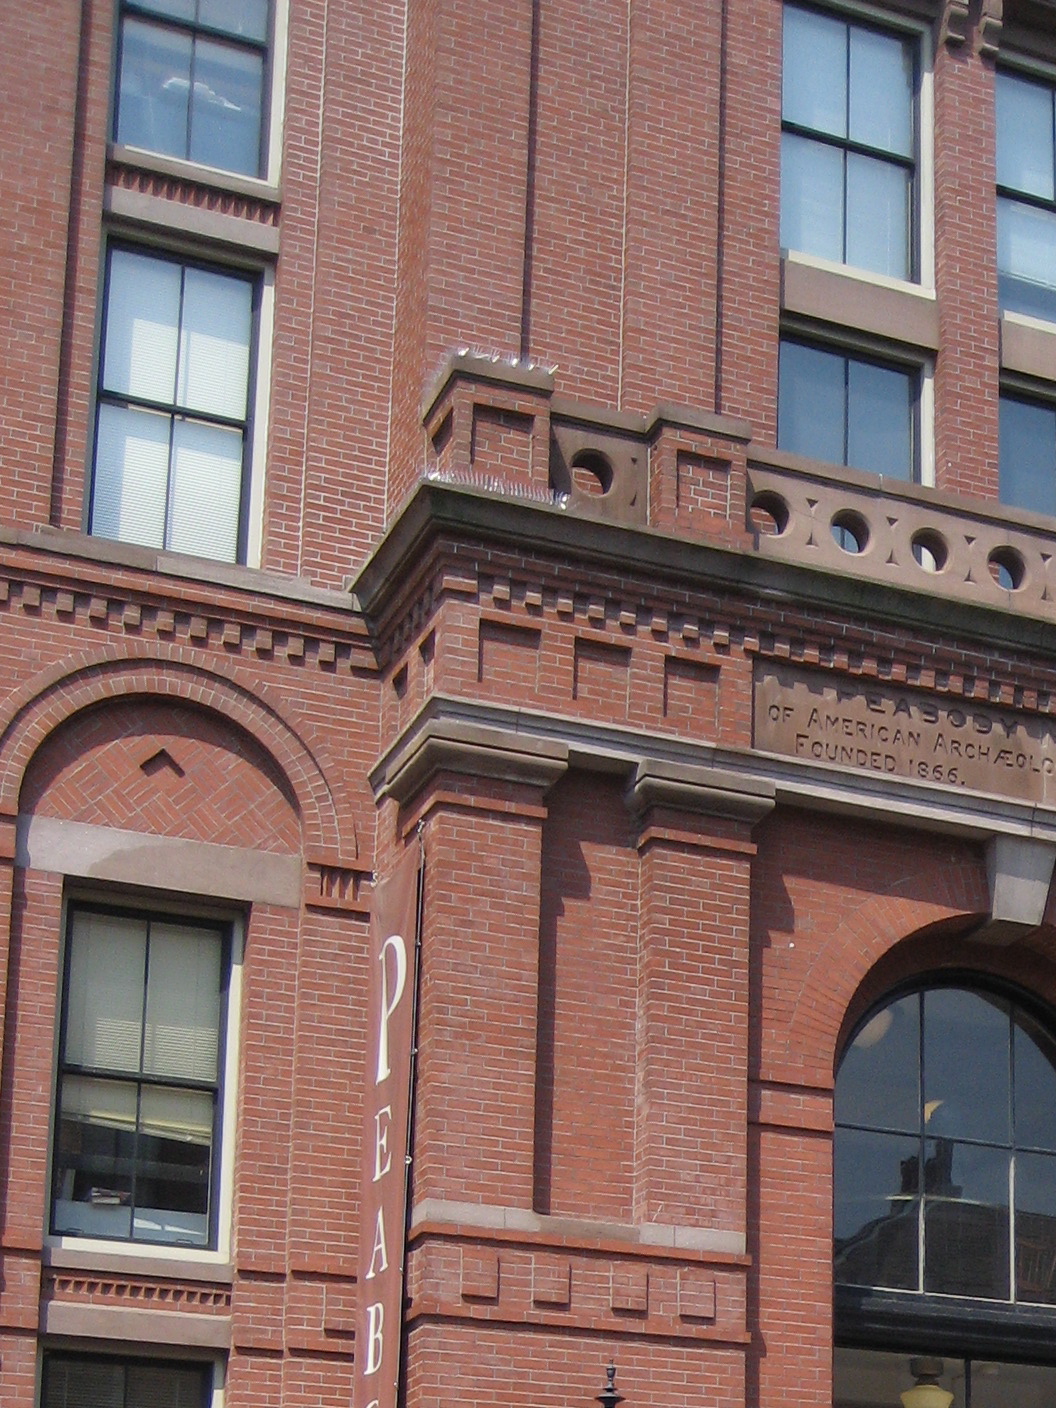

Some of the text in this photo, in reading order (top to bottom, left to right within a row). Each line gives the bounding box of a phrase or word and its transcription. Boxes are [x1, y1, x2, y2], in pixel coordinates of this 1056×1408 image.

[767, 704, 795, 723] OF
[806, 707, 922, 748] AMERICAN
[838, 683, 1021, 739] PEABODY
[794, 733, 967, 786] FOUNDED 1866.
